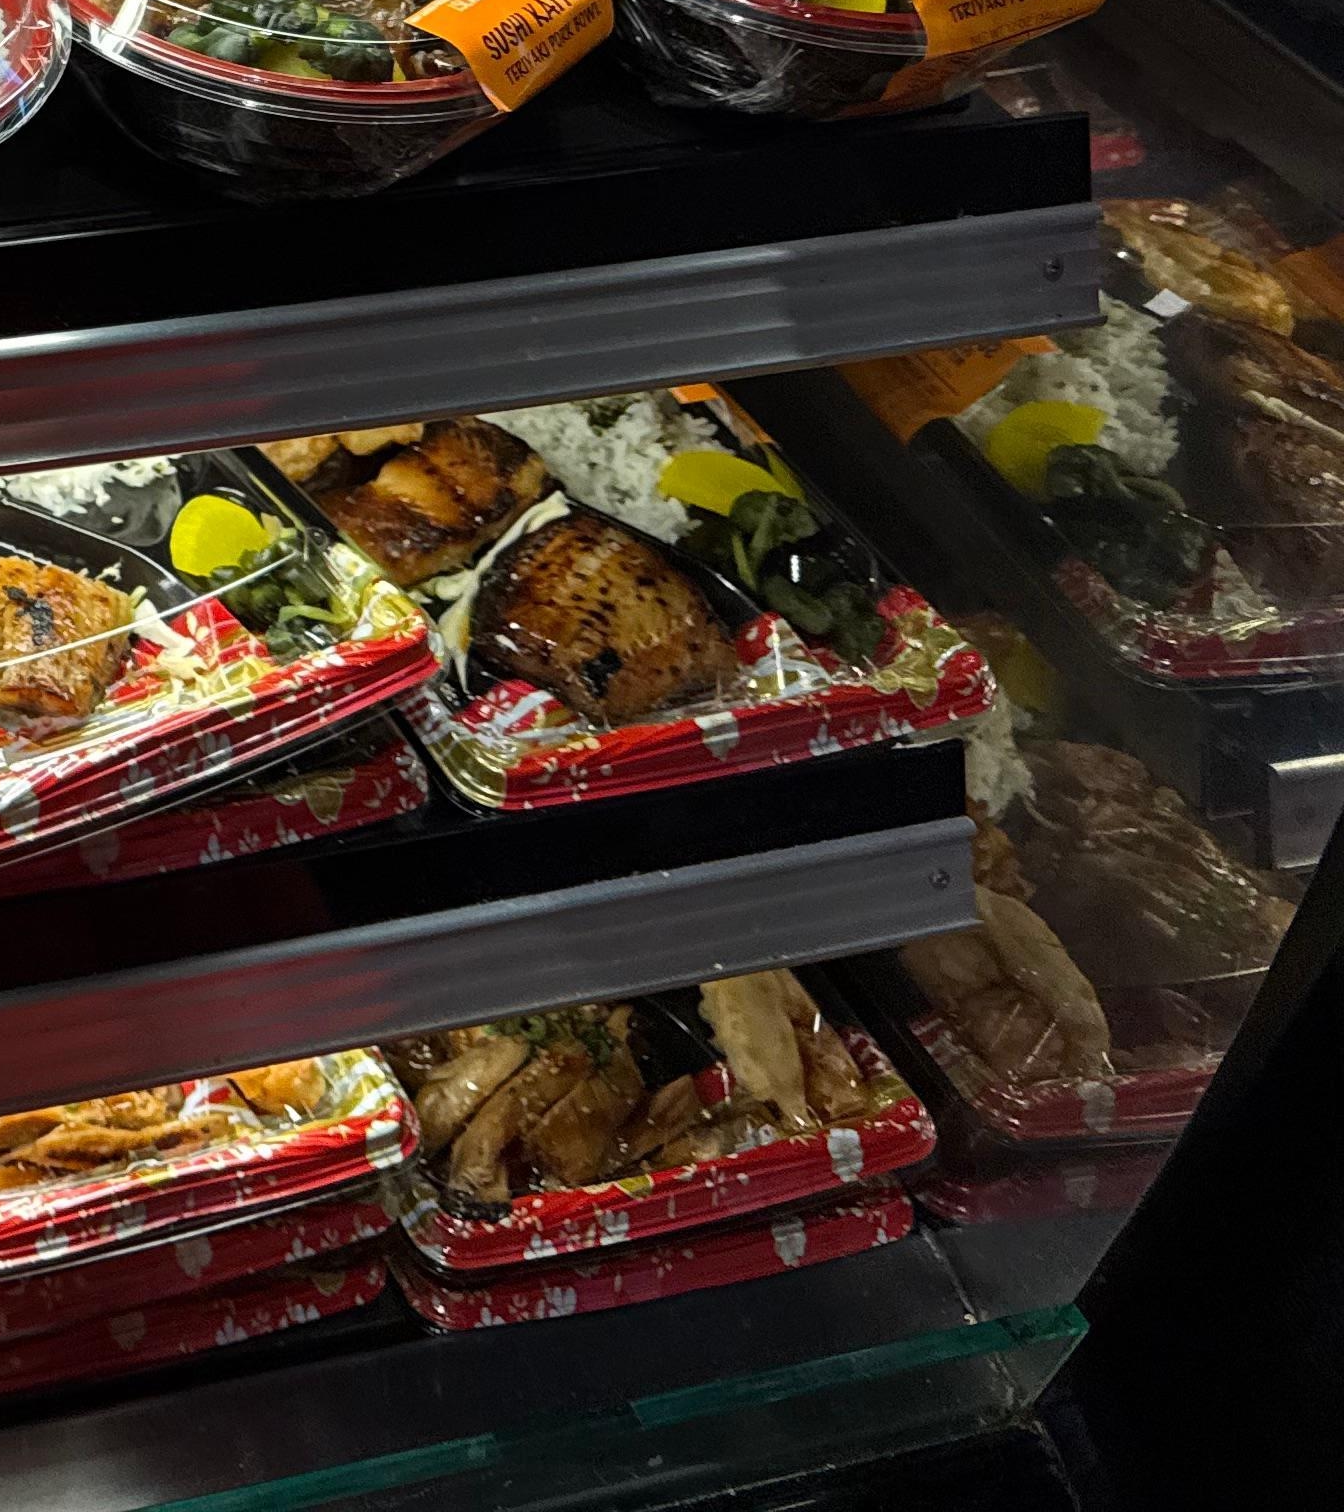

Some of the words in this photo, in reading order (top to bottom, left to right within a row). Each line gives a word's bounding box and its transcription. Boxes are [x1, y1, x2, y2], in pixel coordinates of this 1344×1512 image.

[504, 41, 552, 85] TERIYAKI
[548, 21, 576, 54] PORK
[573, 1, 603, 35] BOWL
